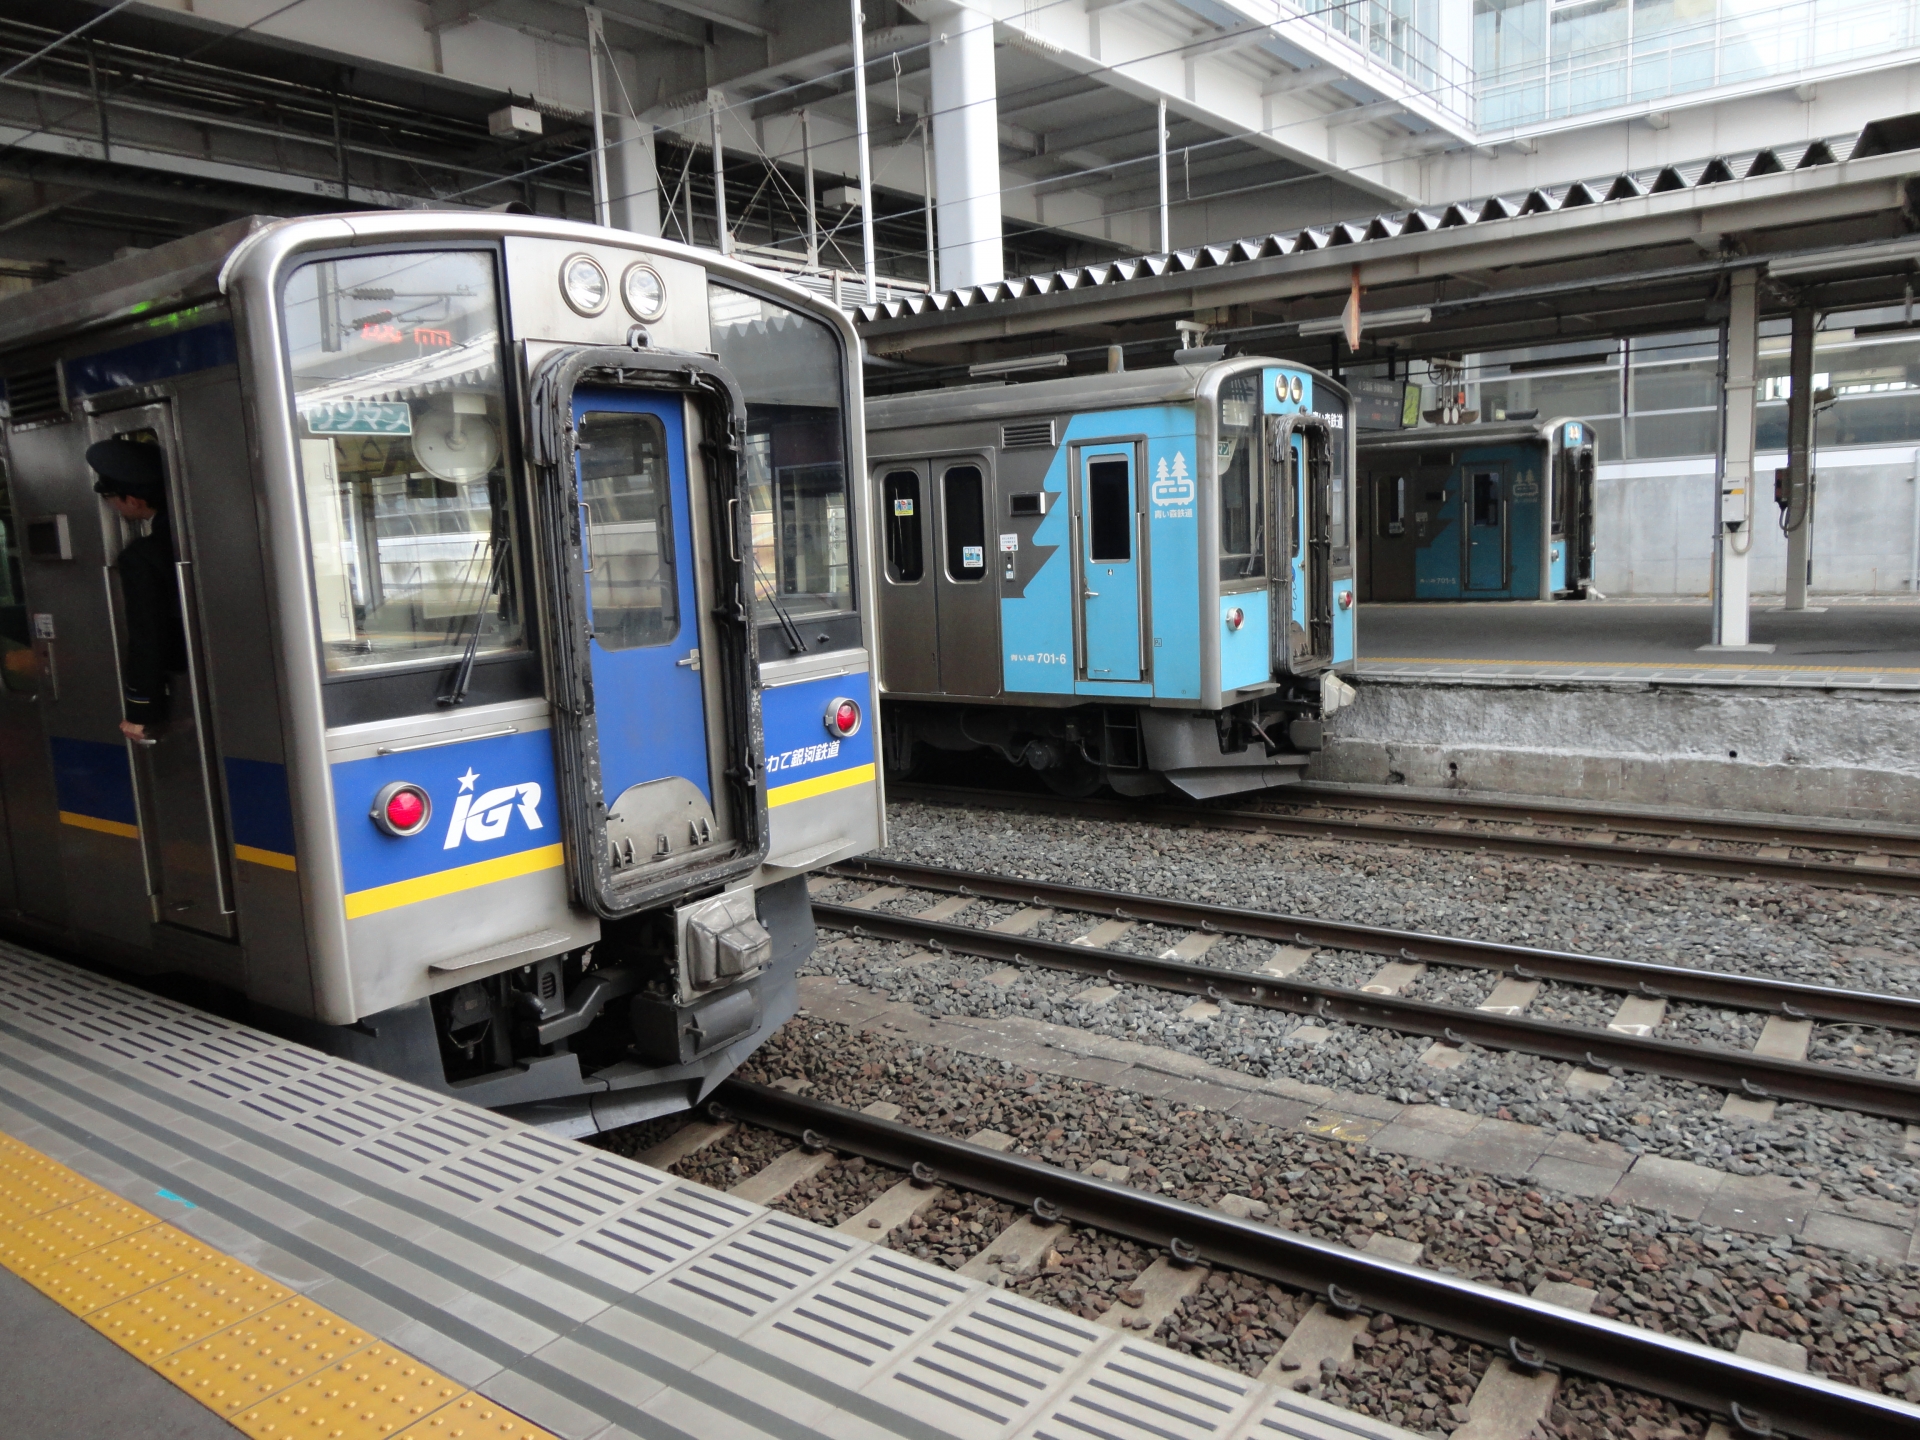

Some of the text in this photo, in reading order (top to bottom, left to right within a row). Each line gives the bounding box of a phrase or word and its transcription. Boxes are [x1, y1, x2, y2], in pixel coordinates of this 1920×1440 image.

[1313, 411, 1343, 428] 森鉄道
[1036, 653, 1066, 664] 701-6
[764, 740, 841, 773] わて銀河鉄道
